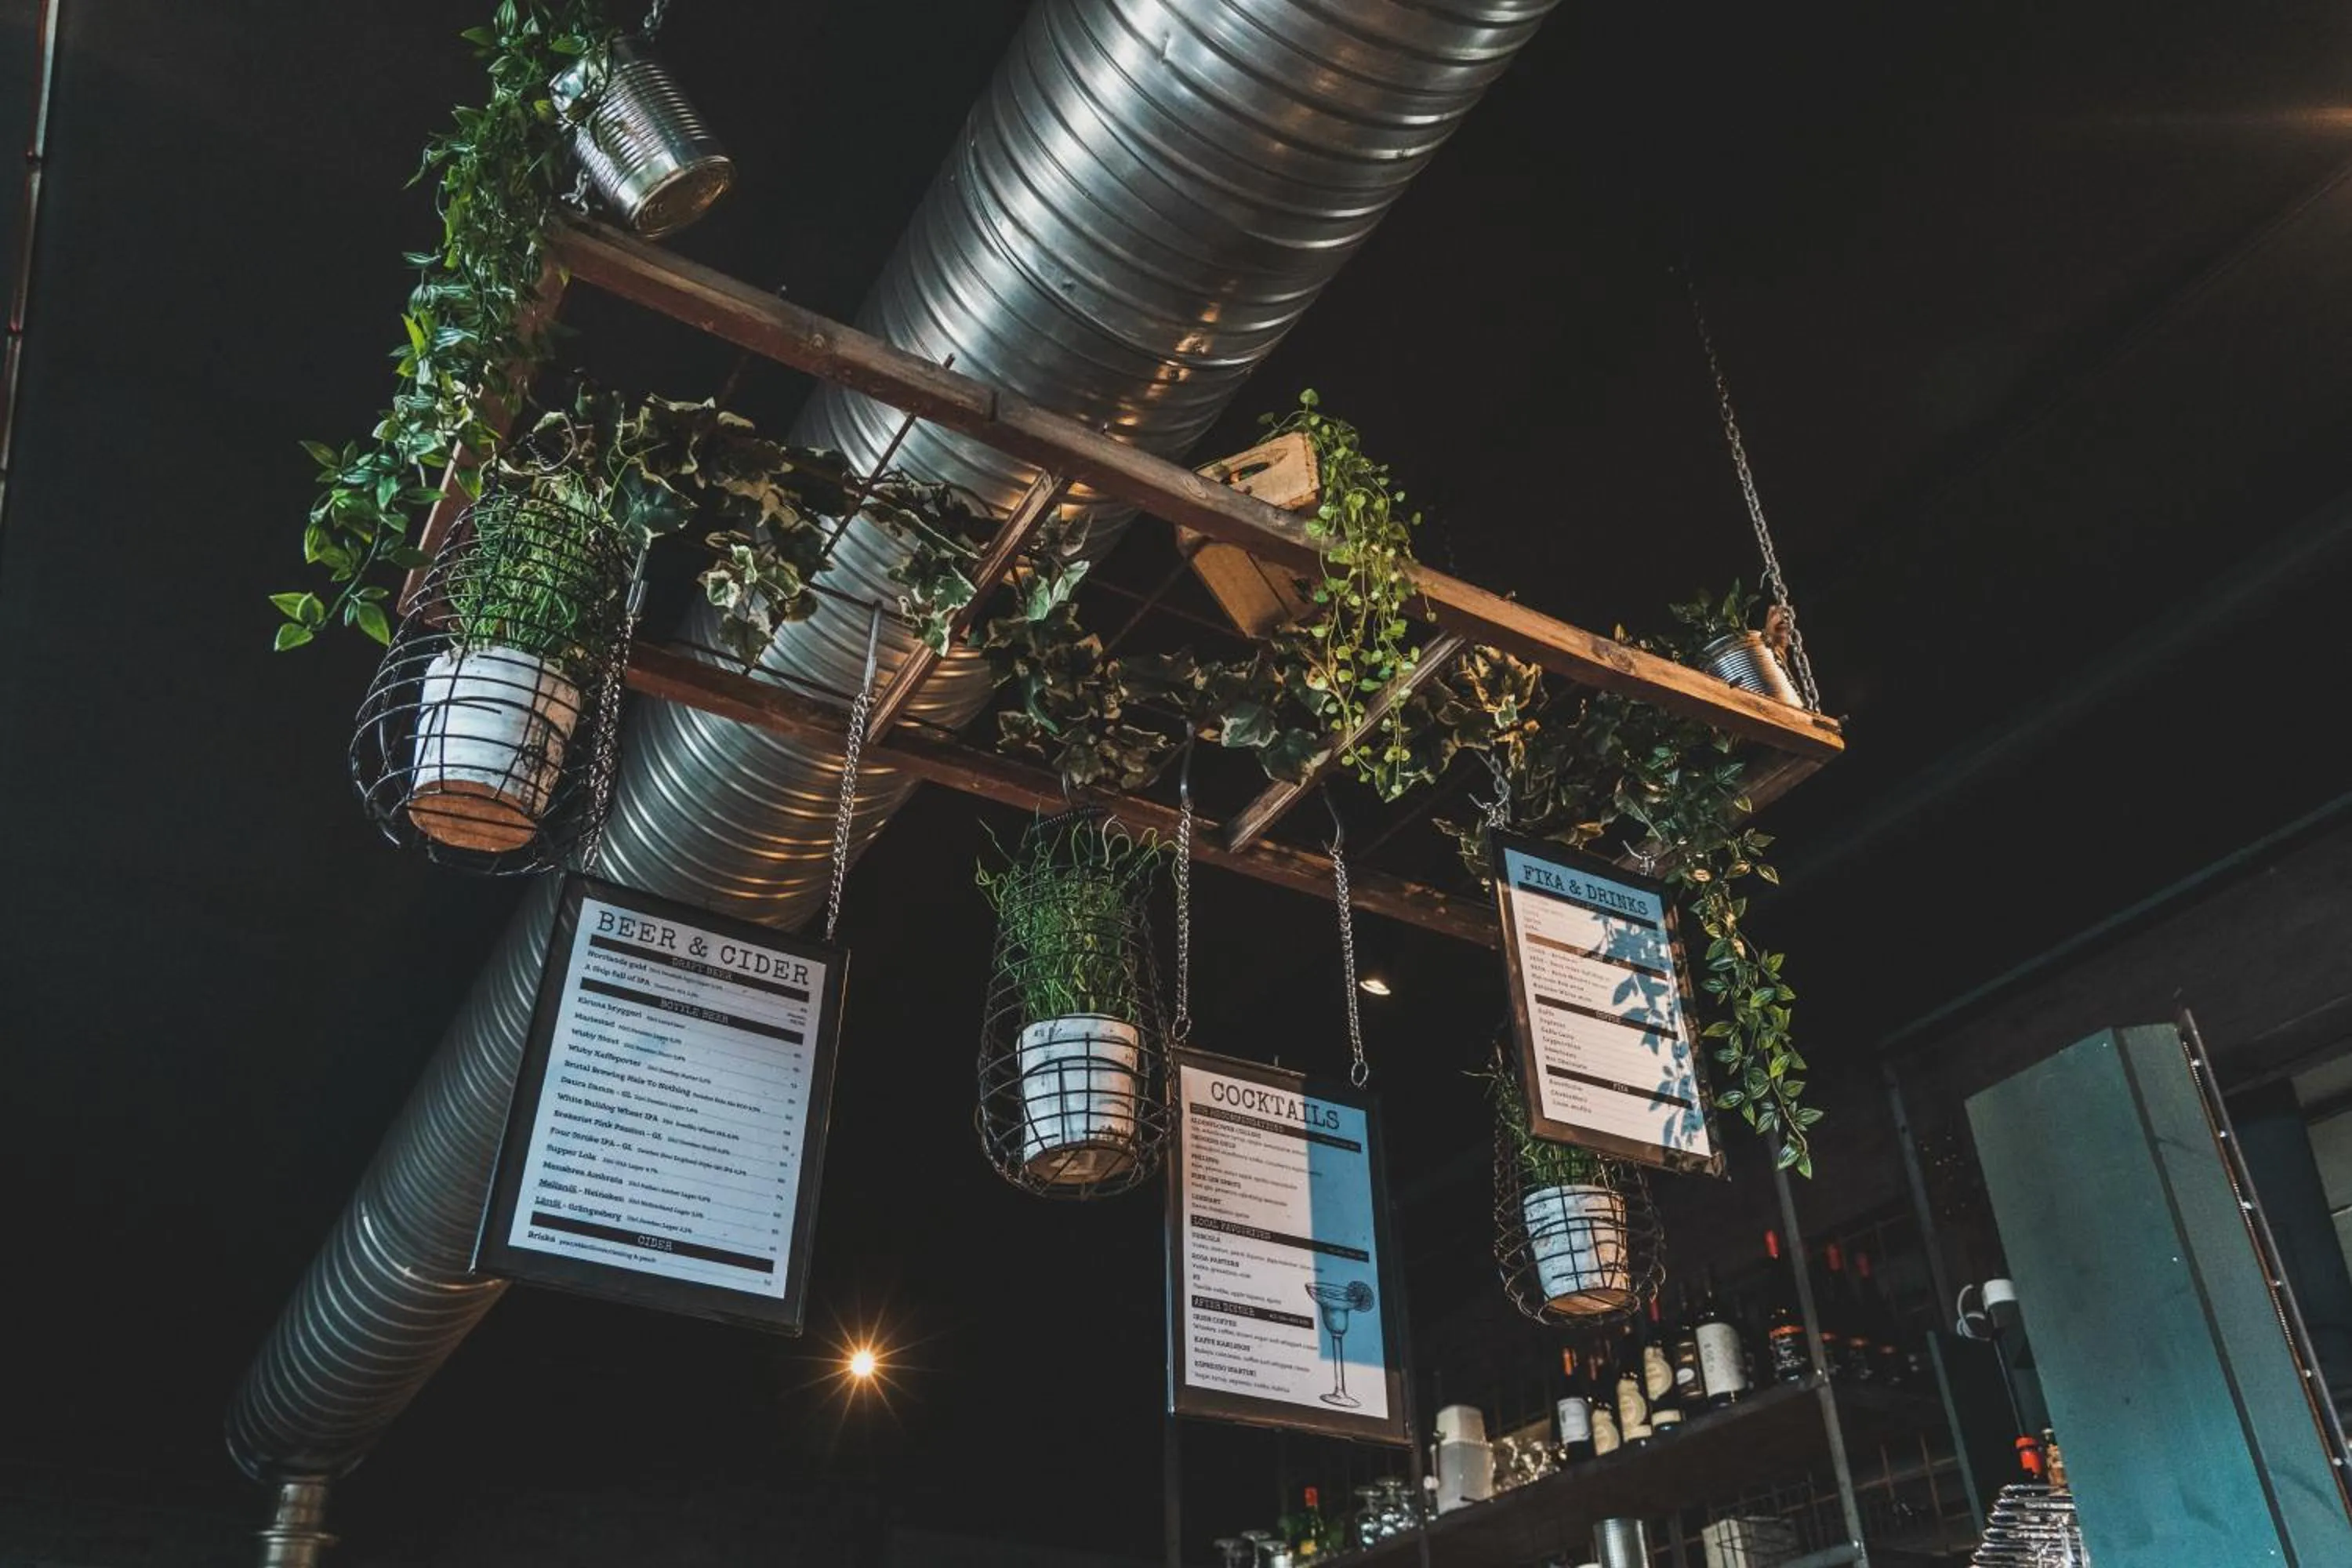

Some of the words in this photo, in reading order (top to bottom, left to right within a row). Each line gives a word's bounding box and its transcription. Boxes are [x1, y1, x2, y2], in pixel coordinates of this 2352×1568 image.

[1523, 865, 1564, 890] FIKA
[1567, 877, 1581, 895] &
[1586, 884, 1648, 915] DRINKS
[597, 911, 678, 949] BEER
[688, 935, 709, 957] &
[720, 944, 809, 984] CIDER
[557, 1093, 582, 1104] White
[584, 1099, 615, 1112] Bulldog
[644, 1112, 658, 1121] IPA
[658, 1082, 690, 1096] Nothing
[1211, 1081, 1338, 1128] COCKTAILS
[637, 1236, 672, 1250] CIDER
